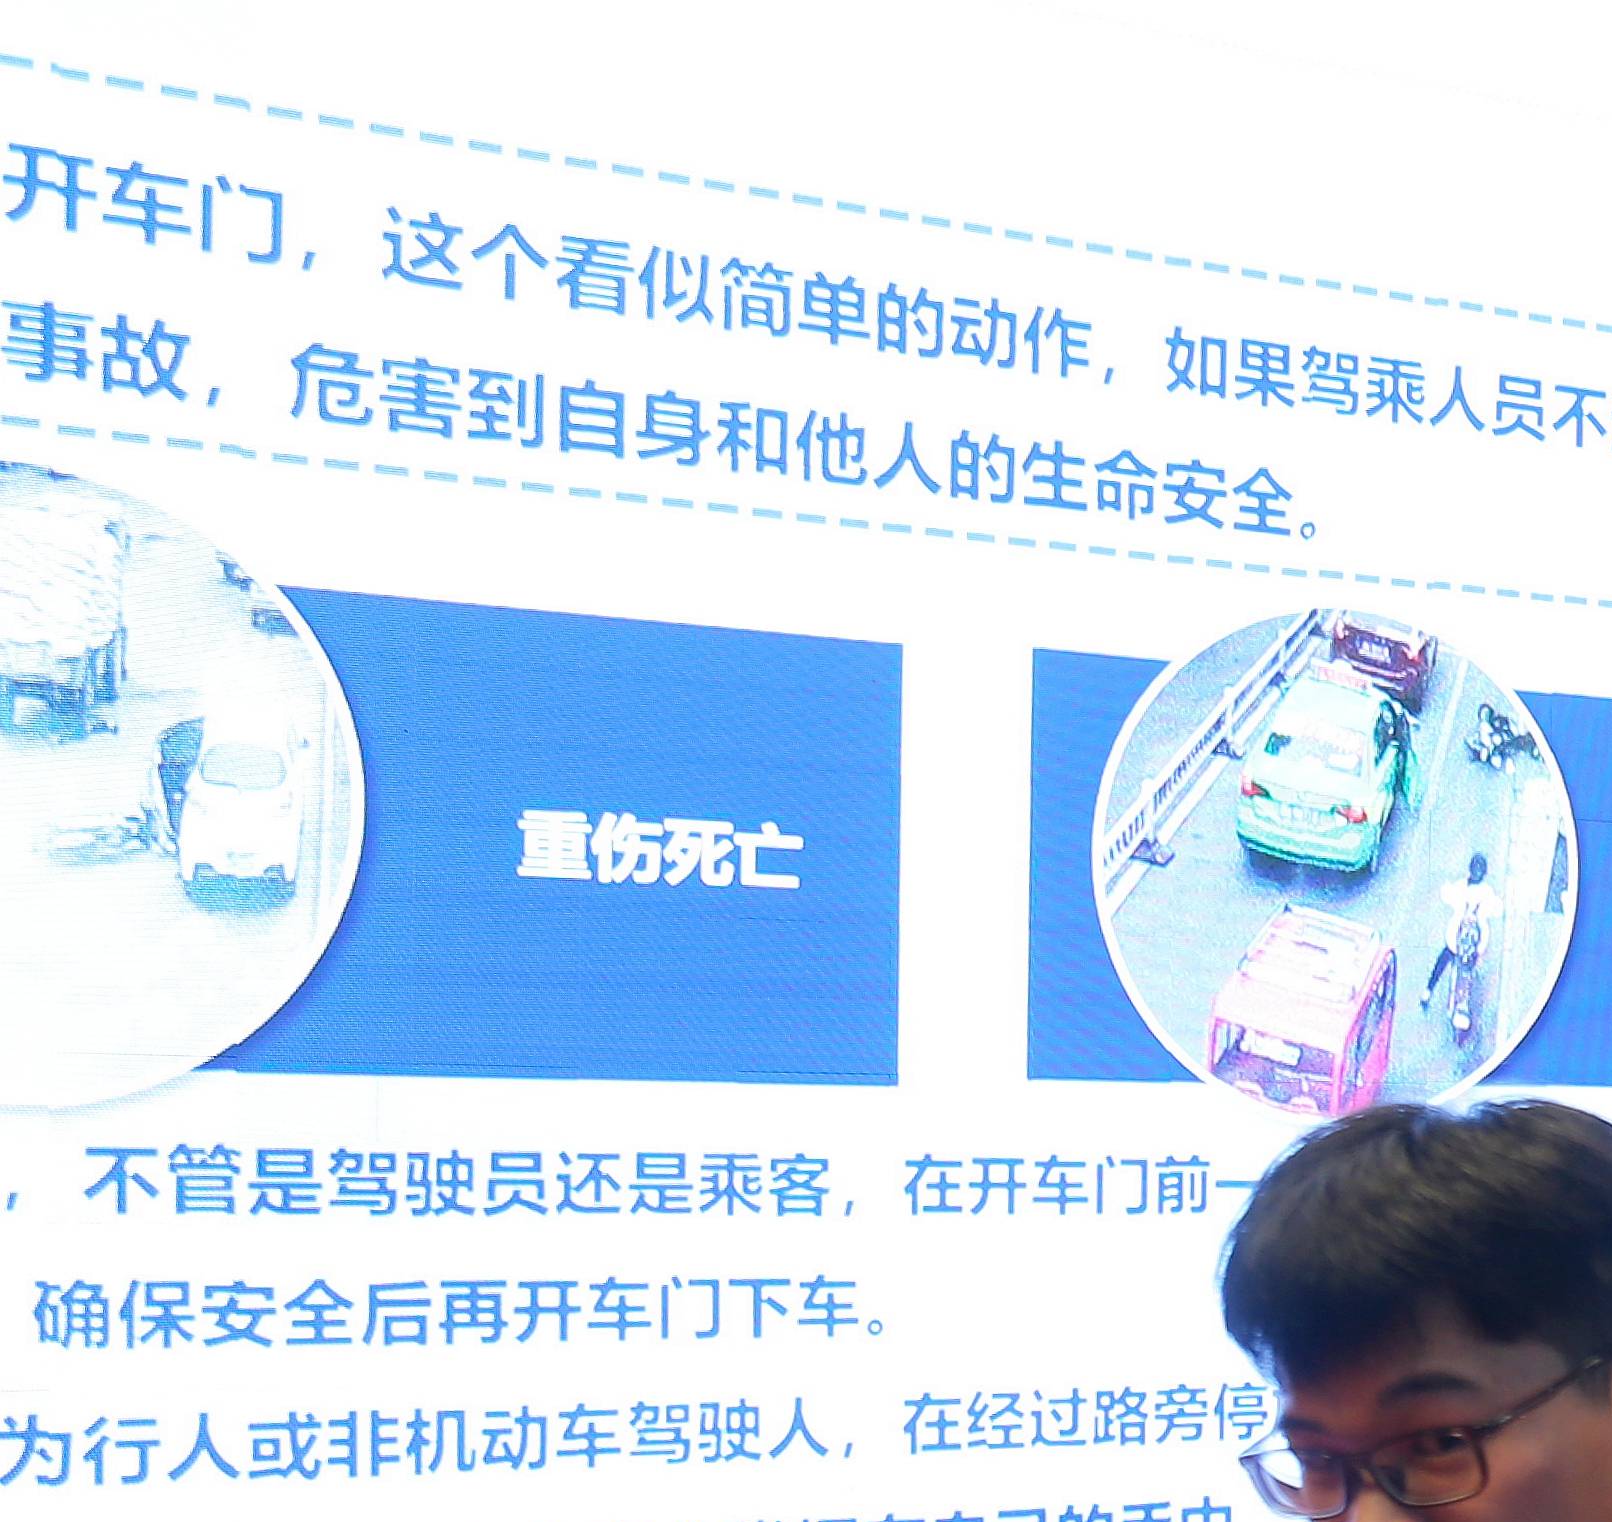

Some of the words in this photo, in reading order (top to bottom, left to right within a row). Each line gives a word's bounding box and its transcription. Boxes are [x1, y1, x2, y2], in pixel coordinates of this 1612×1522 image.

[0, 301, 1317, 540] 事故，危害到自身和他人的生命安全。
[517, 810, 804, 888] 重伤死亡
[33, 1274, 884, 1350] 确保安全后再开车门下车。
